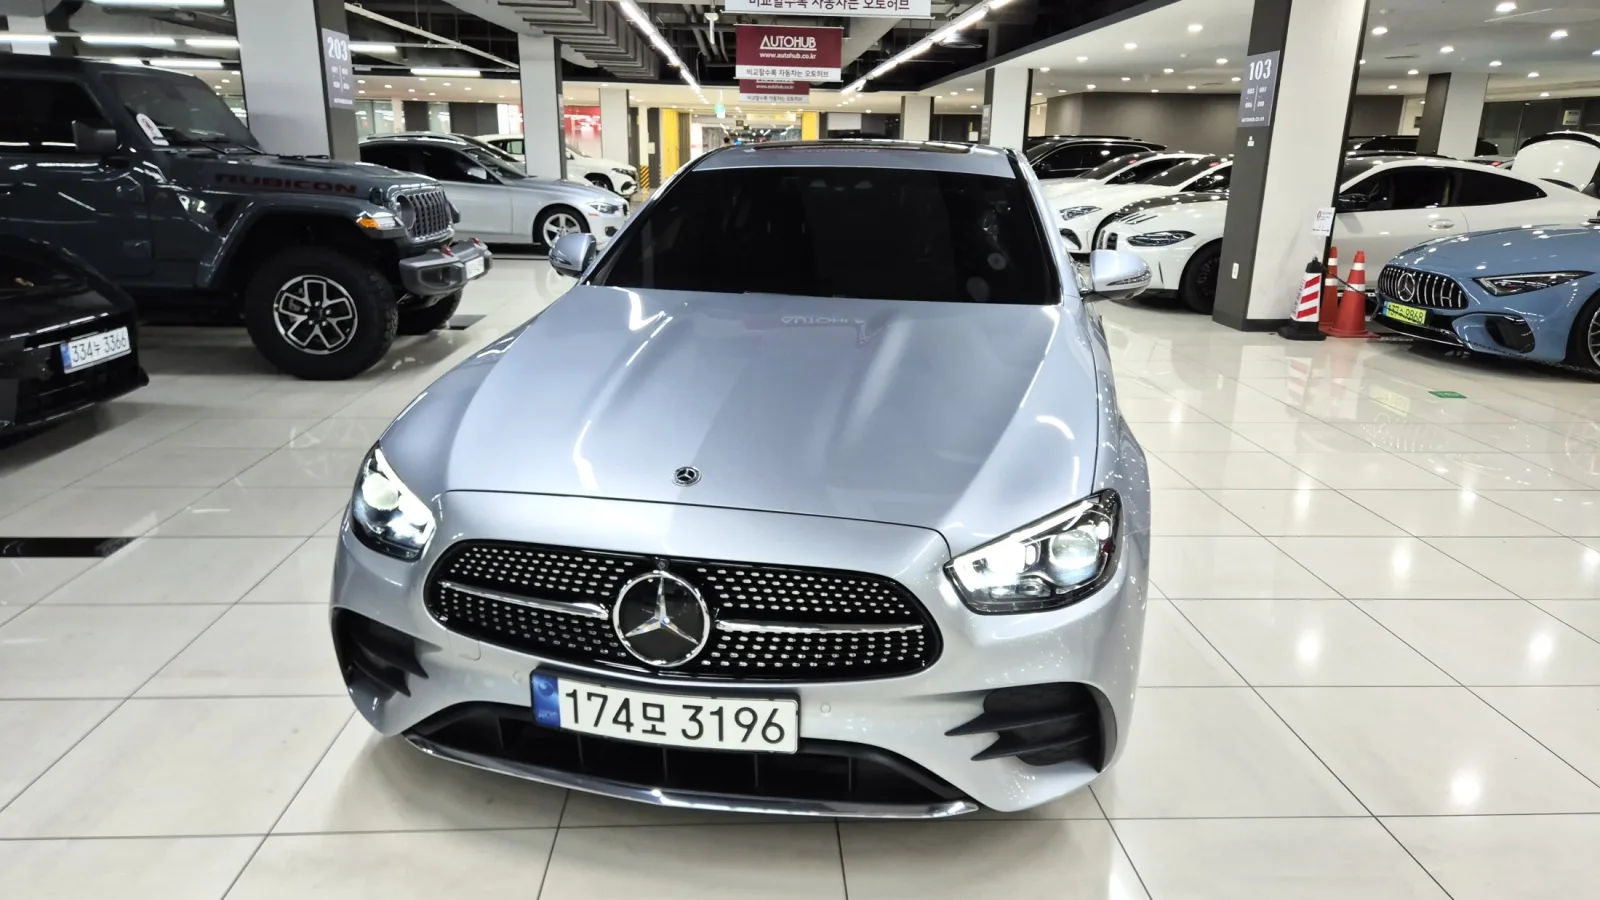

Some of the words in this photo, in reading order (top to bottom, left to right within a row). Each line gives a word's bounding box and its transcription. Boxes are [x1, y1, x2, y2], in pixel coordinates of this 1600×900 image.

[327, 36, 348, 61] 203
[760, 35, 817, 51] AUTOHUB
[759, 52, 817, 60] www.autohub.co.kr
[746, 68, 777, 77] 비교할수록
[778, 69, 803, 78] 자동차는
[804, 70, 829, 78] 오토허브
[1249, 59, 1272, 81] 103
[215, 173, 357, 193] RUBICON
[71, 341, 101, 363] 334누
[103, 331, 127, 353] 3366
[565, 688, 667, 737] 174모
[681, 704, 786, 745] 3196
